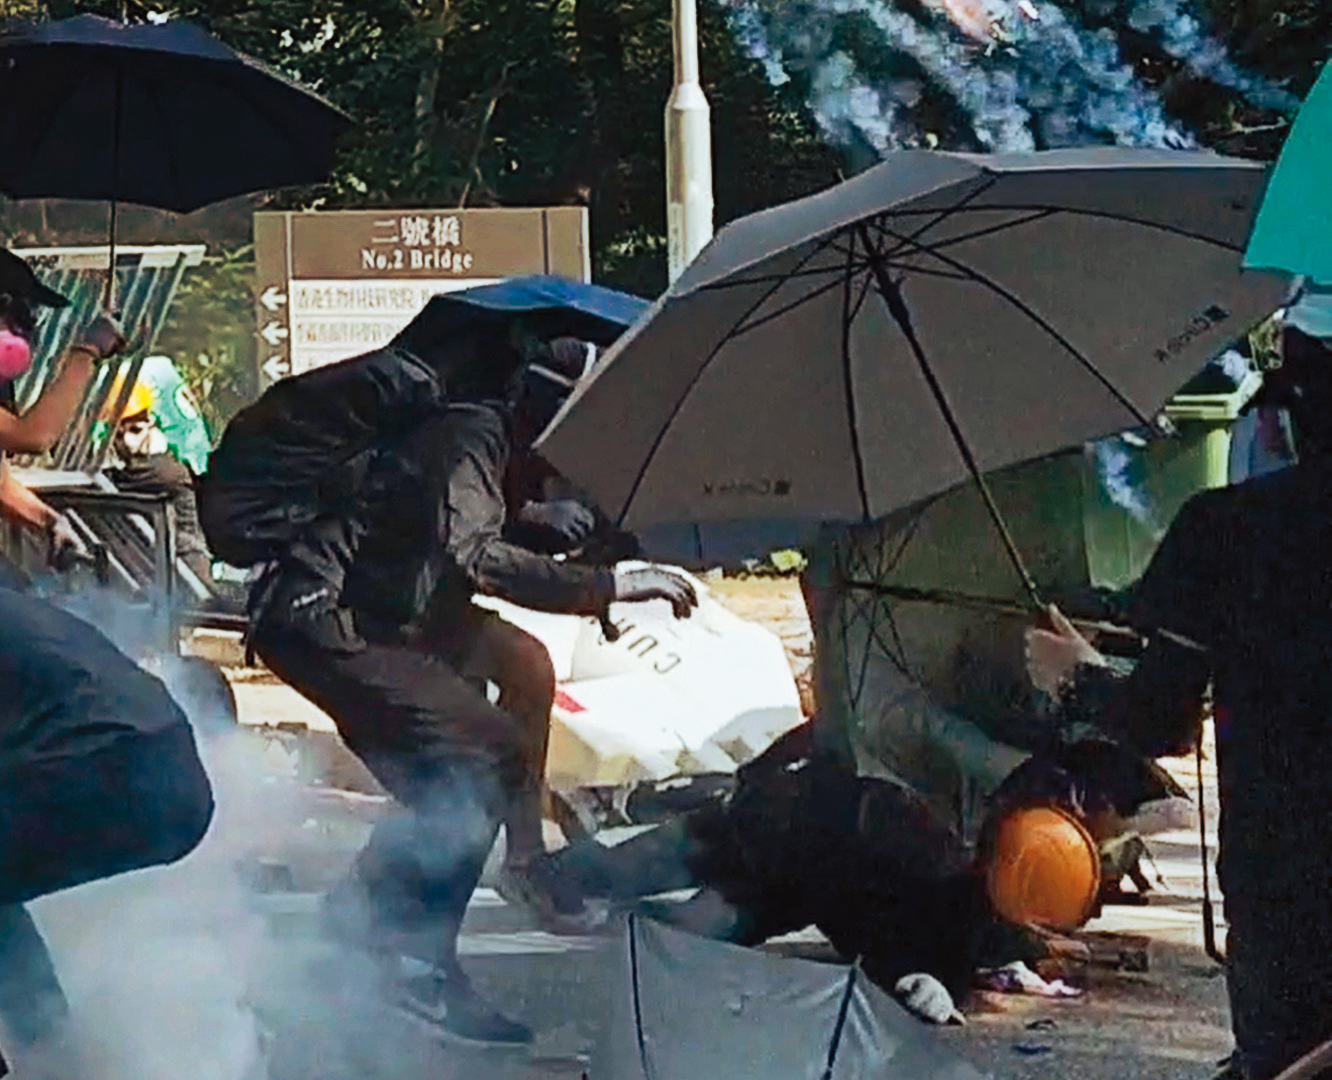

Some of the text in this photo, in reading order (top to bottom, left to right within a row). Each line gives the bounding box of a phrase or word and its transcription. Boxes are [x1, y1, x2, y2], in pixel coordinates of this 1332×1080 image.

[372, 216, 460, 246] 二號橋
[361, 248, 473, 274] No.2 Bridge
